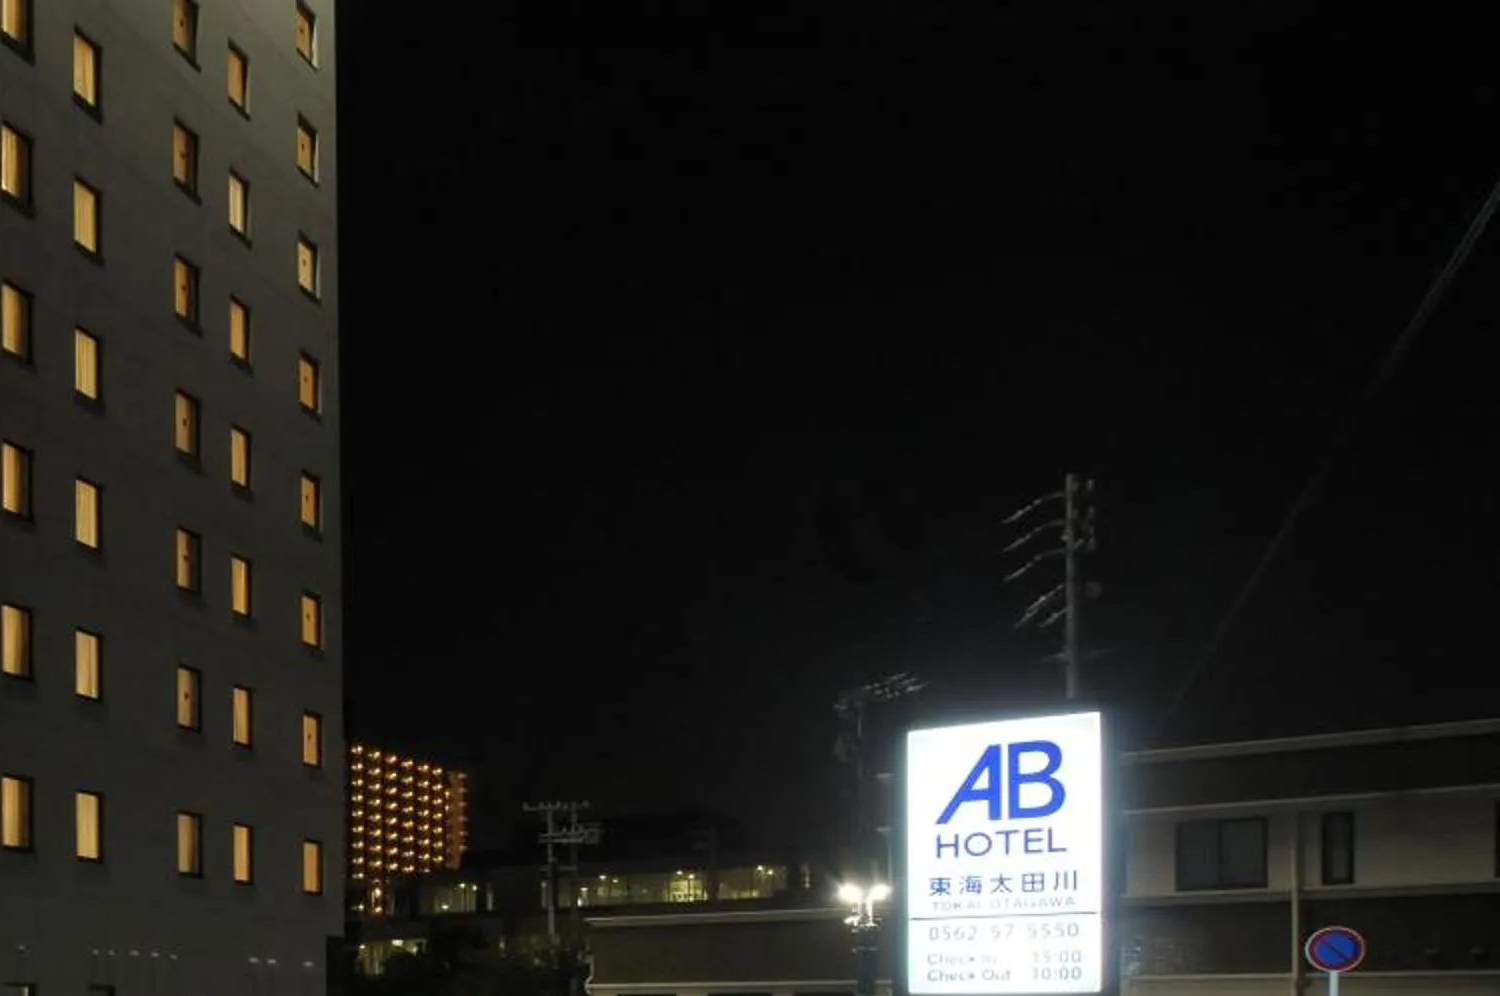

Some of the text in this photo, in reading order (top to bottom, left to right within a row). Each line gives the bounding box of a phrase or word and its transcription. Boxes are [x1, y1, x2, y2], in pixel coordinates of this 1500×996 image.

[935, 740, 1066, 825] AB
[936, 827, 1068, 858] HOTEL
[929, 870, 1078, 896] 東海太田川
[1032, 966, 1083, 981] 10:00
